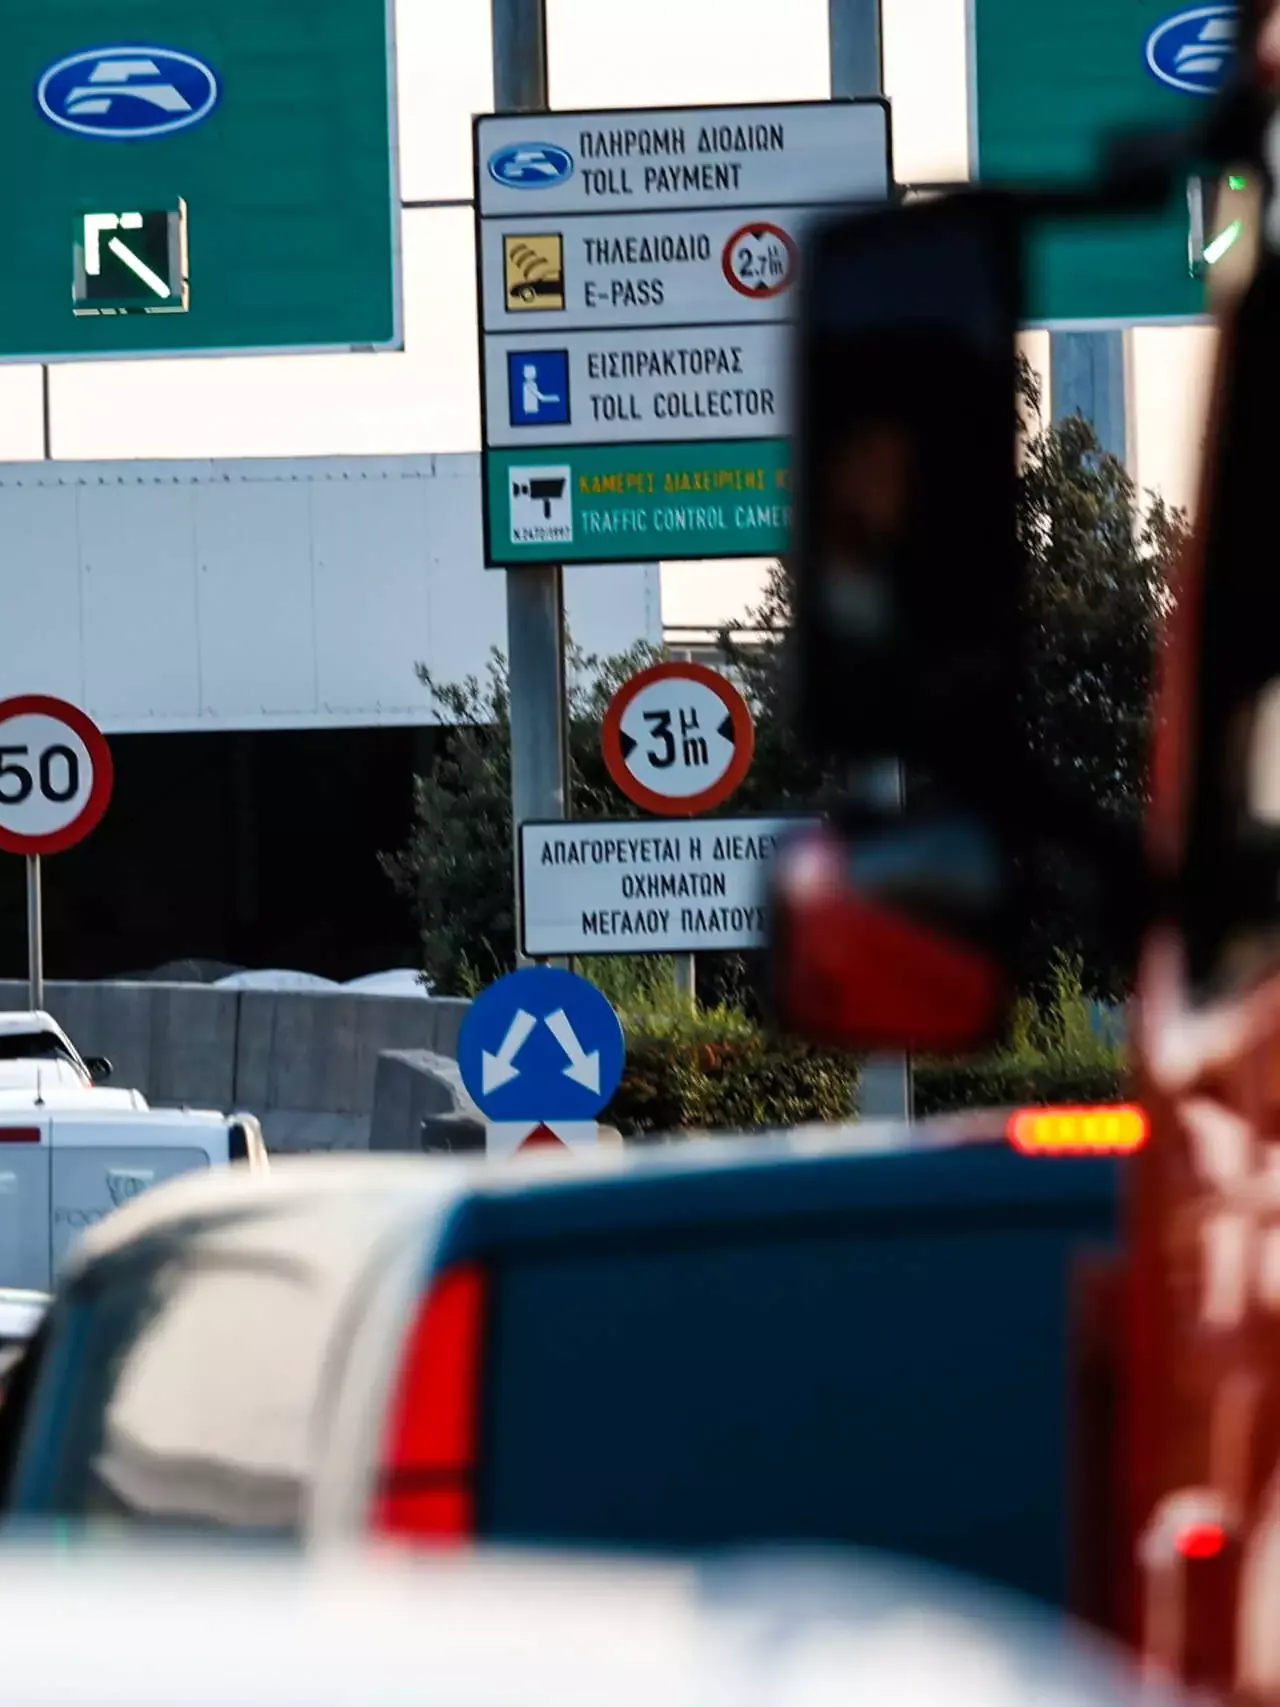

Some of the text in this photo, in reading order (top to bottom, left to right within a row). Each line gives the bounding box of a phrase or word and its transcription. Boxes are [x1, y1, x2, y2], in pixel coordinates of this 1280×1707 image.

[579, 123, 785, 159] ΠΛΗΡΩΜΗ ΔΙΟΔΙΩΝ
[581, 163, 742, 197] TOLL PAYMENT
[583, 233, 710, 266] ΤΗΛΕΔΙΟΔΙΟ
[584, 280, 665, 308] E-PASS
[588, 347, 744, 379] ΕΙΣΠΡΑΚΤΟΡΑΣ
[591, 389, 777, 422] TOLL COLLECTOR
[581, 508, 648, 535] TRAFFIC
[653, 505, 728, 533] CONTROL
[540, 837, 680, 866] ΑΠΑΓΟΡΕΥΕΤΑΙ
[689, 838, 702, 860] Η
[622, 872, 726, 899] ΟΧΗΜΑΤΩΝ
[582, 908, 670, 936] ΜΕΓΑΛΟΥ
